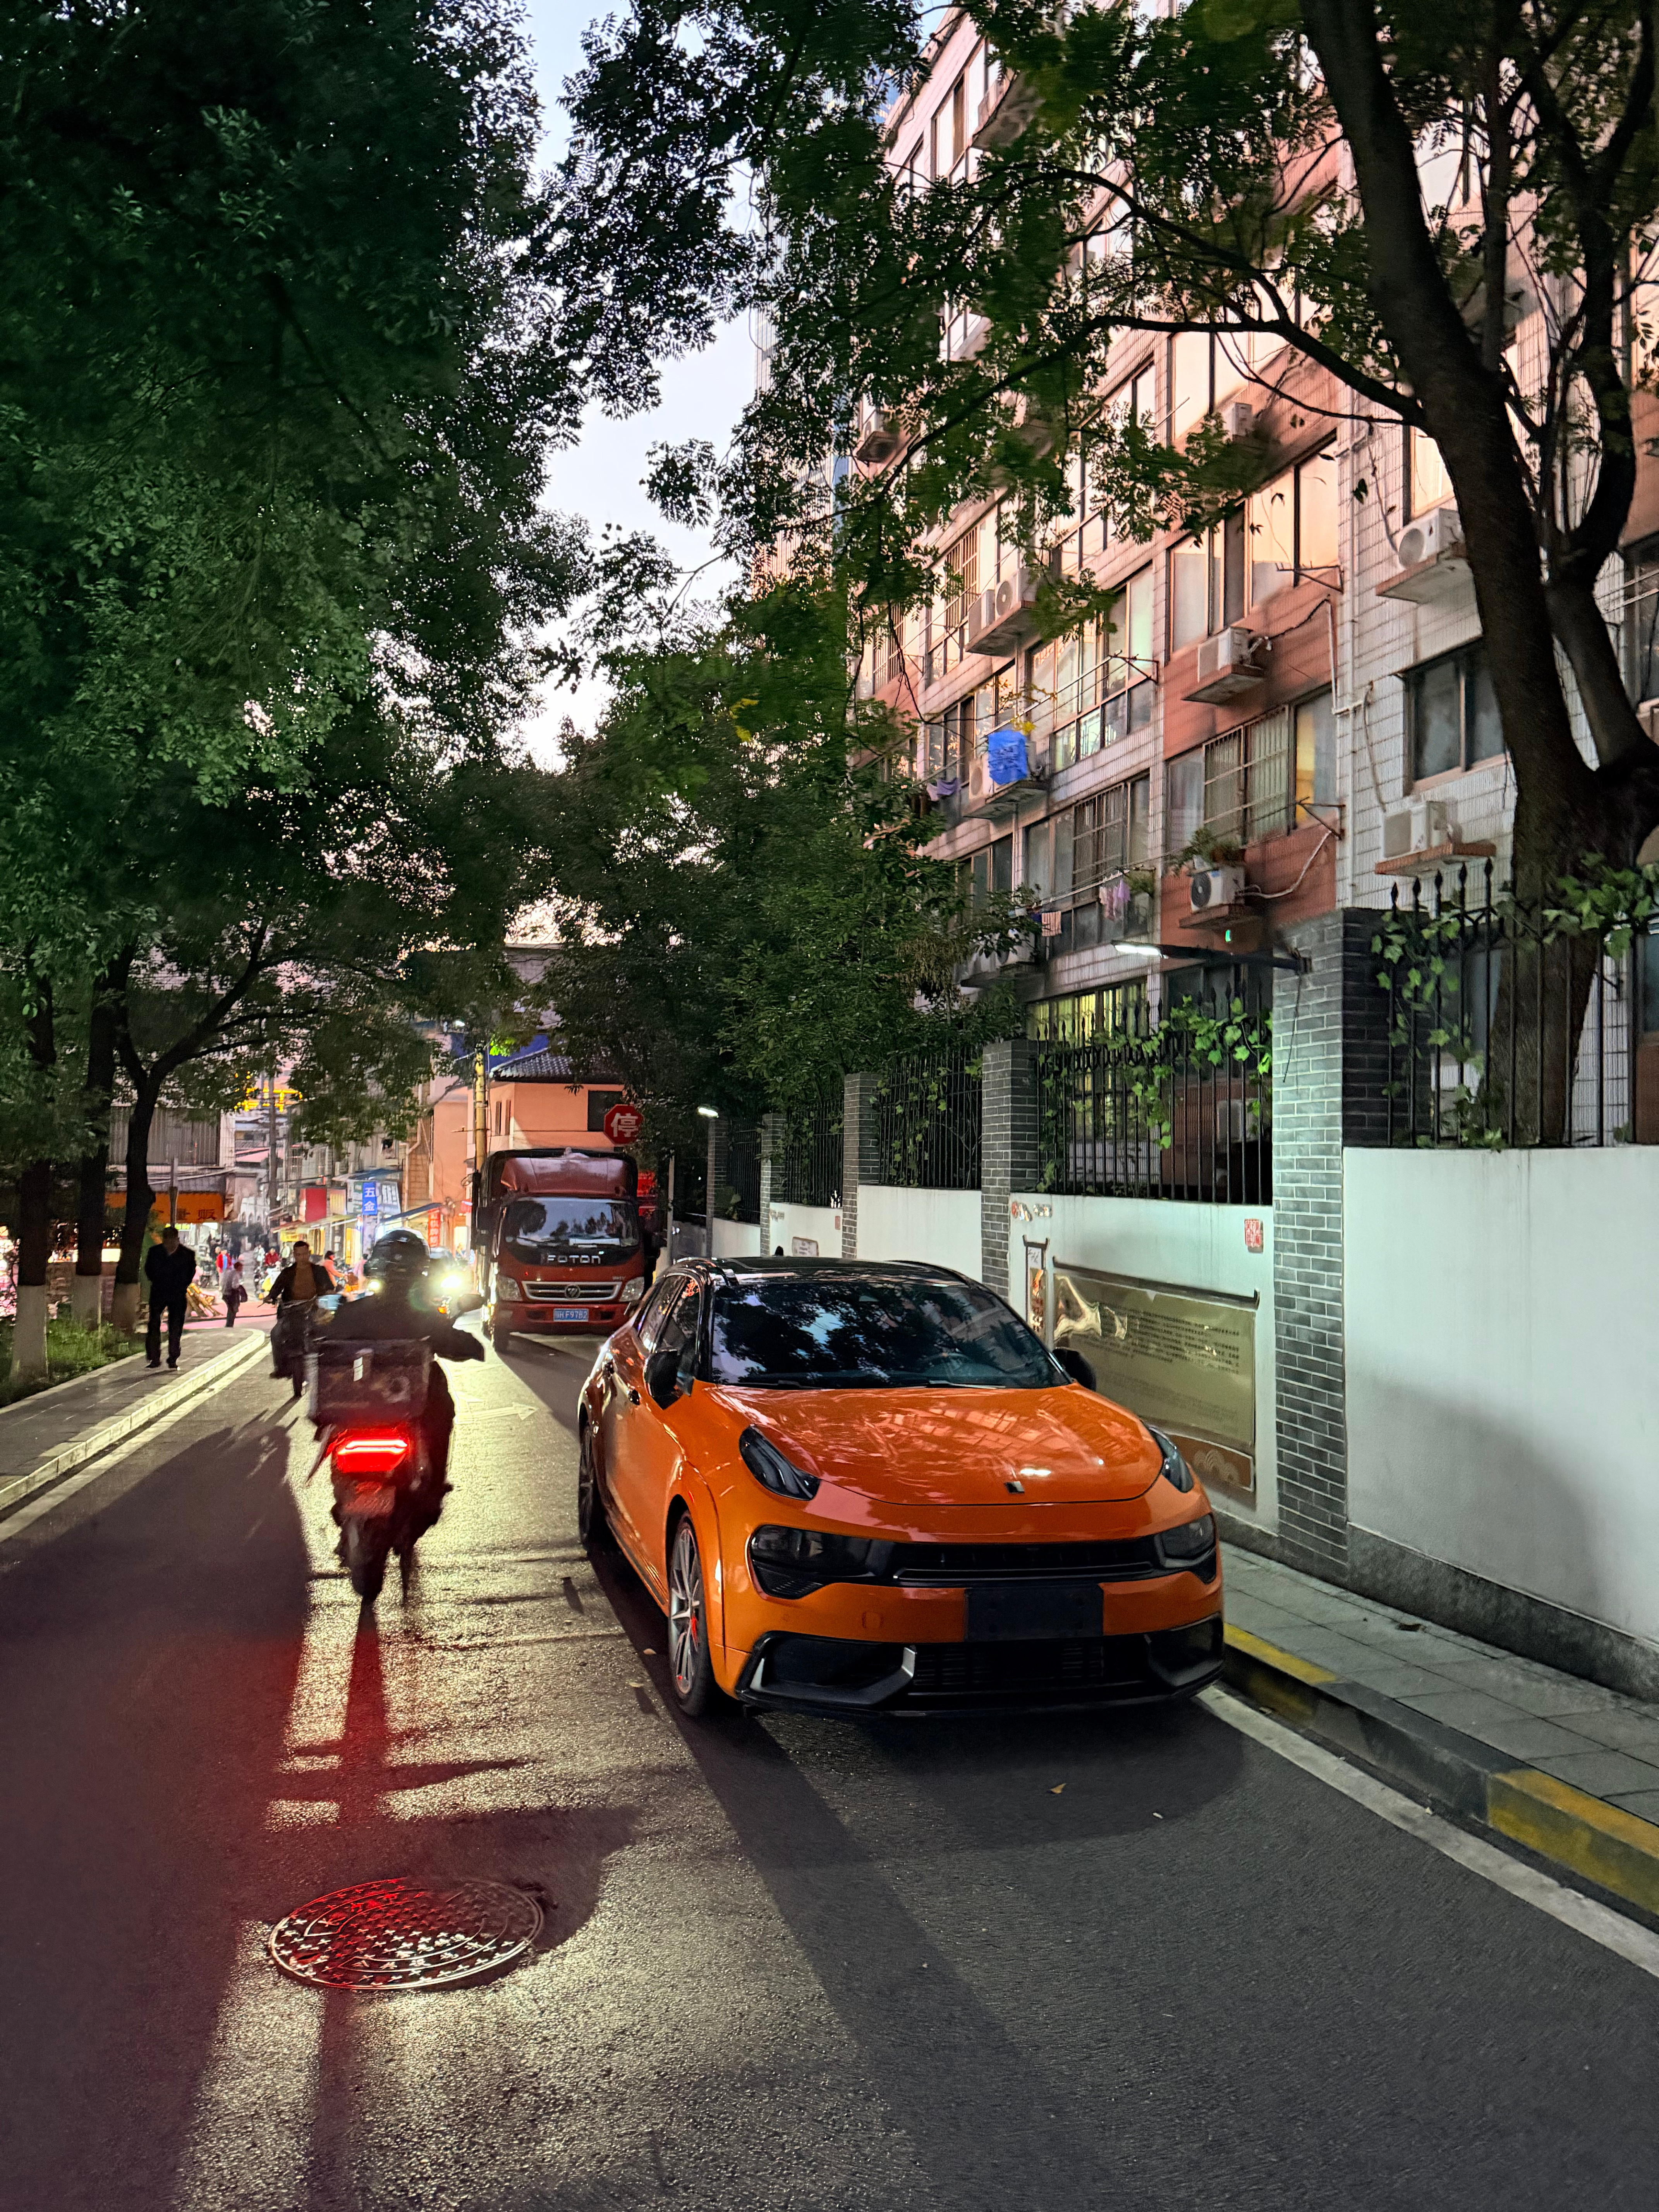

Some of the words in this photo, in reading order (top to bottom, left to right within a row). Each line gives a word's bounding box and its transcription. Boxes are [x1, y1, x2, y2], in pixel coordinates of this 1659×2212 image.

[611, 1113, 638, 1137] 停
[364, 1187, 375, 1211] 五金
[548, 1255, 601, 1264] FOTON
